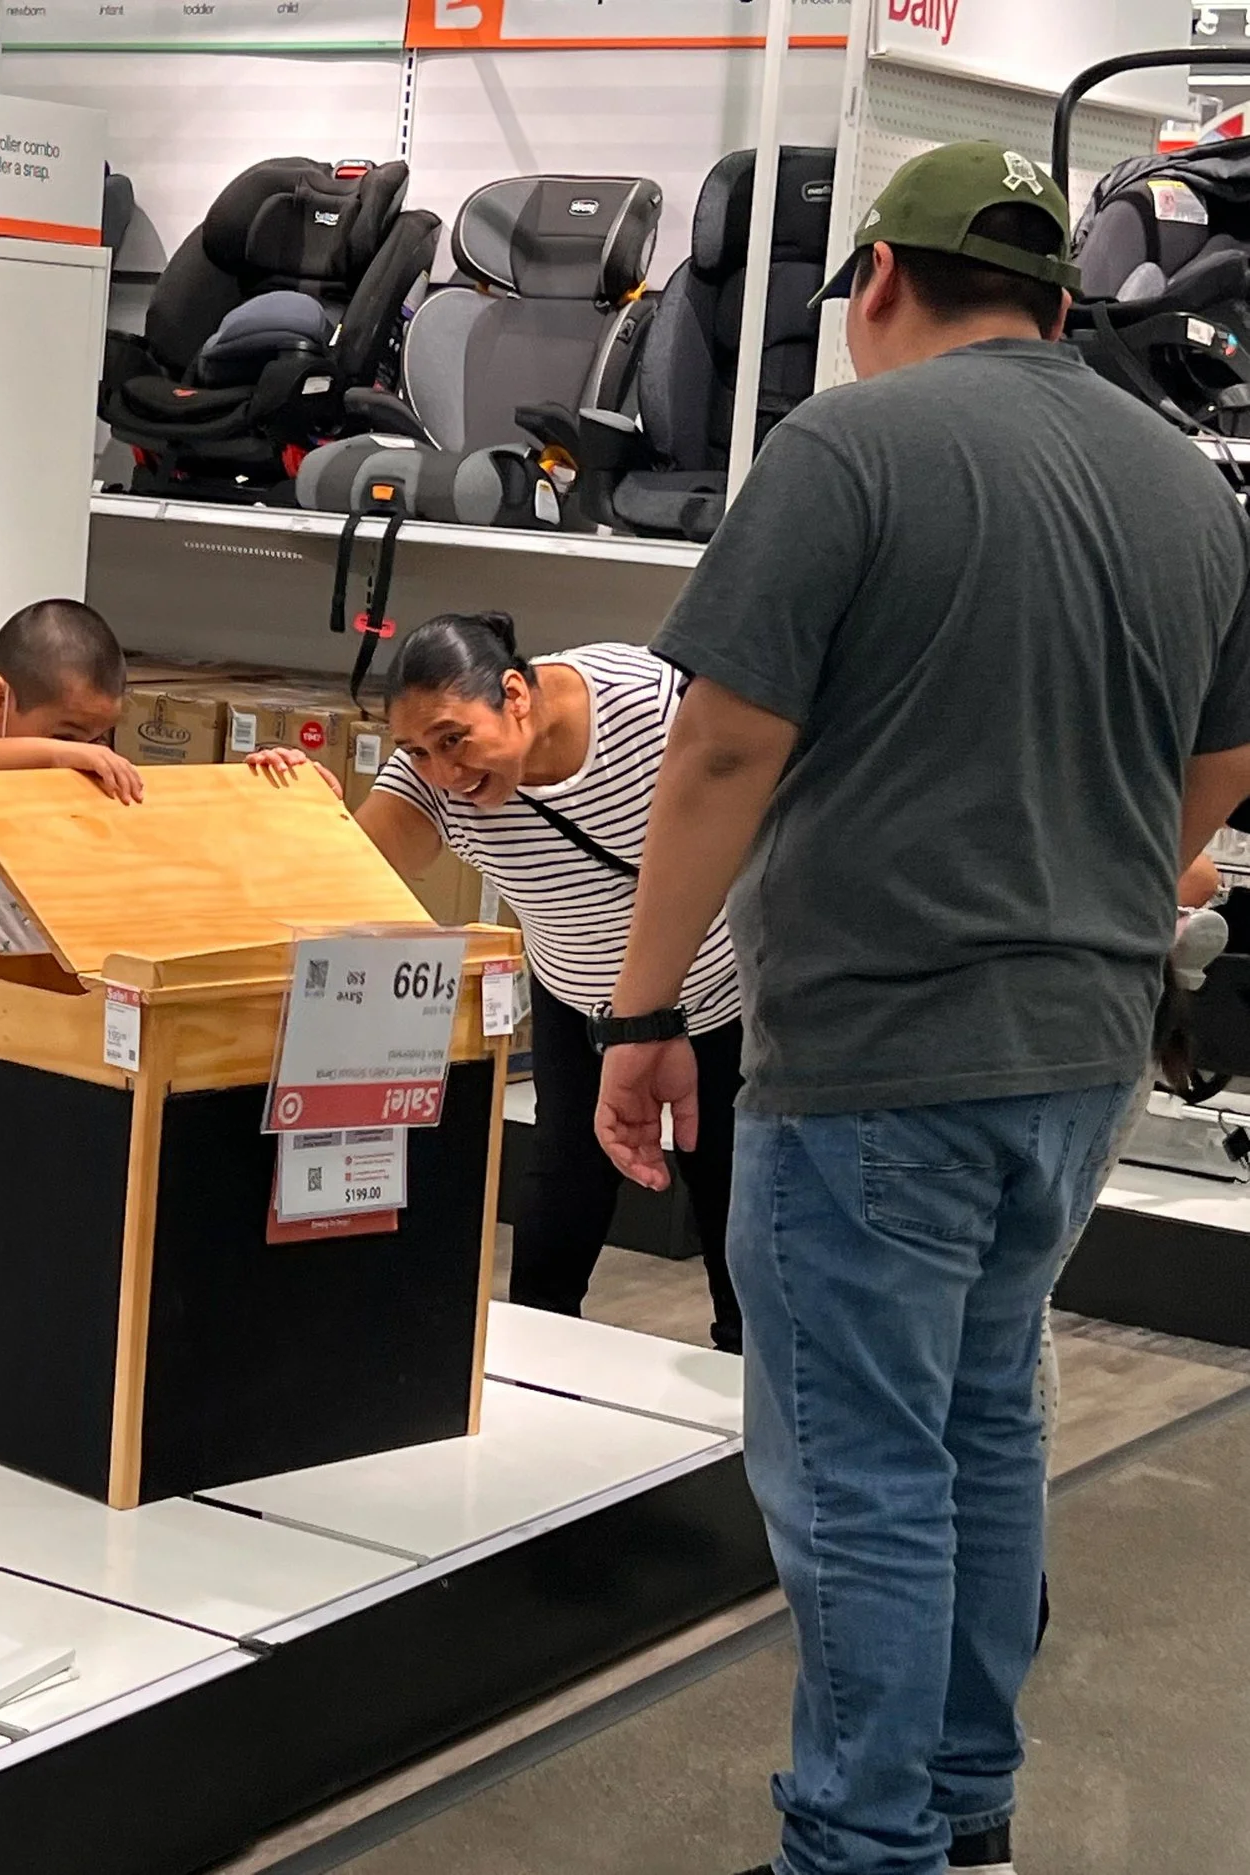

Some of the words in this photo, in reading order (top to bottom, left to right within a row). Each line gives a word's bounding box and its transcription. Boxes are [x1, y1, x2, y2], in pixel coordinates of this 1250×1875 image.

[888, 0, 959, 46] Daily
[23, 138, 60, 159] combo
[14, 162, 22, 176] a
[392, 960, 456, 1001] $199
[335, 990, 364, 1005] Save
[381, 1087, 440, 1120] Sale!
[344, 1186, 382, 1203] $199.00
